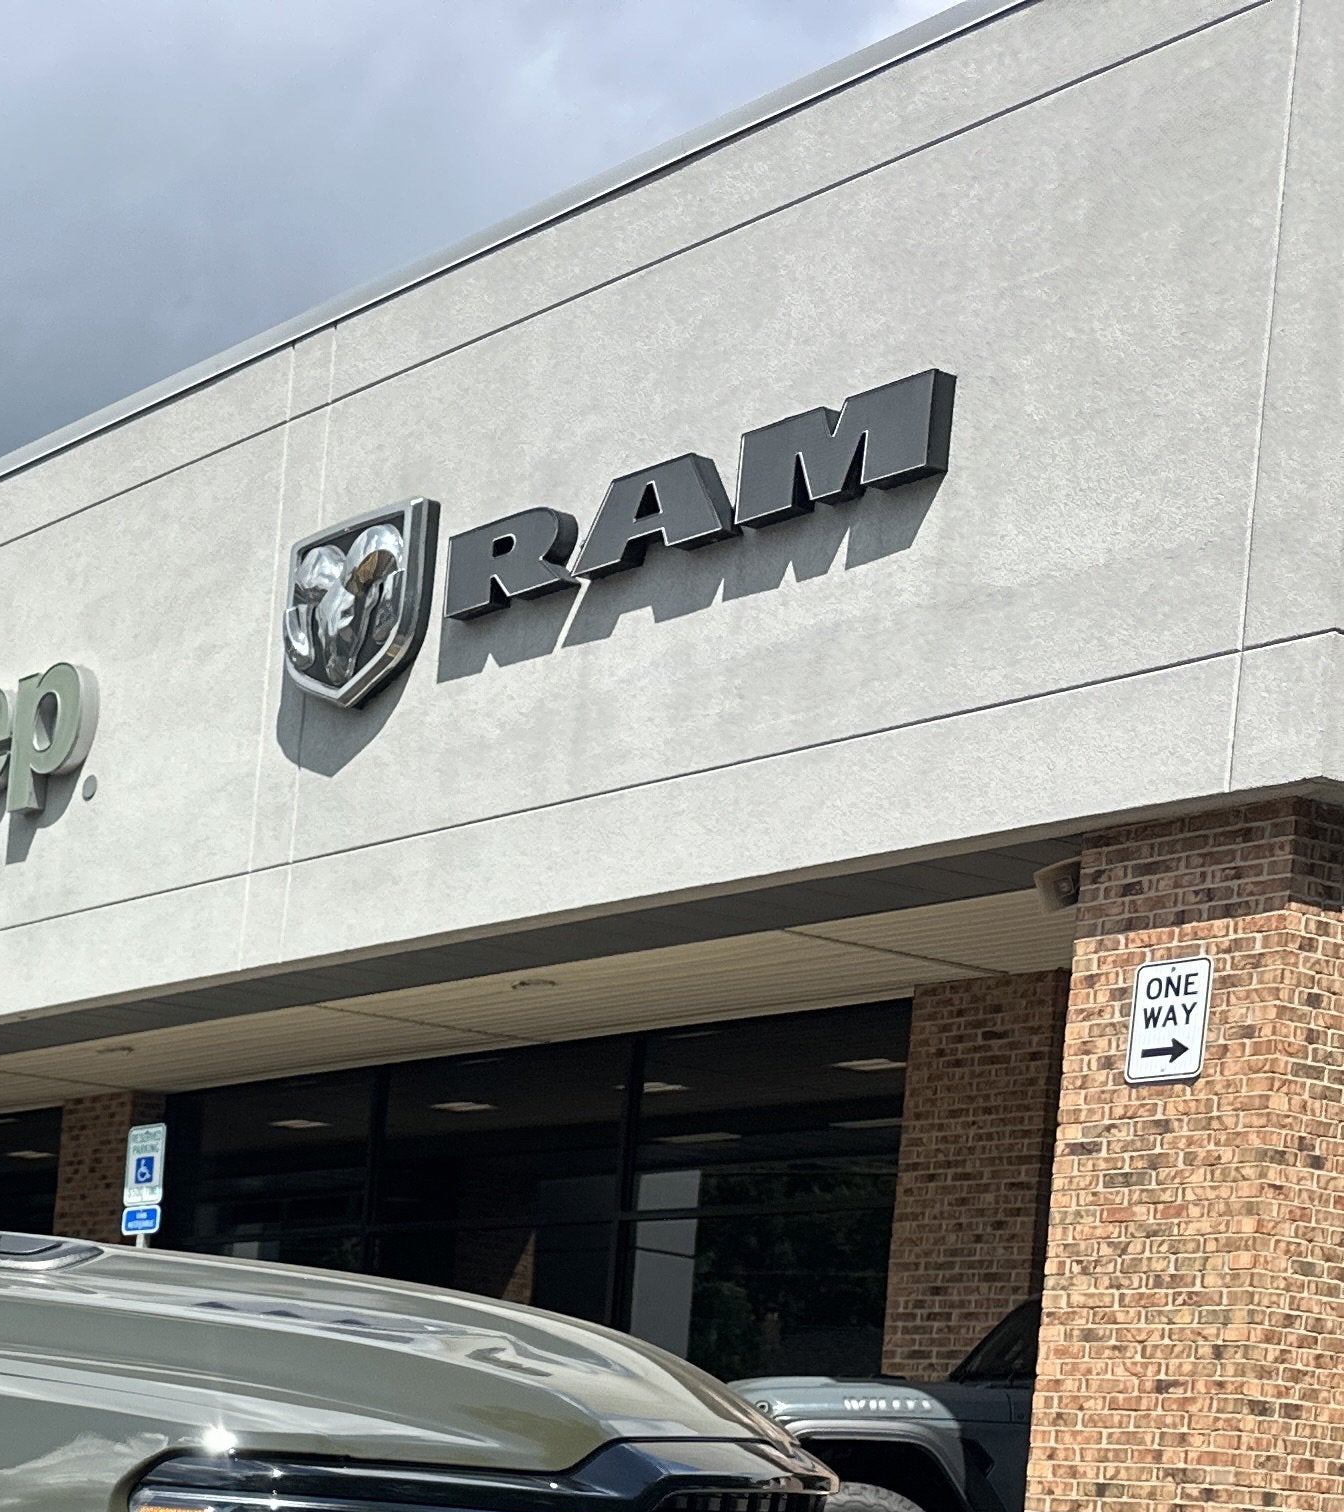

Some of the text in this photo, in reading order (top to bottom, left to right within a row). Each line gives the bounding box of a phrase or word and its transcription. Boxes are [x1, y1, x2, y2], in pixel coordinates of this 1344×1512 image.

[443, 368, 957, 620] RAM
[1146, 972, 1199, 1000] ONE
[1143, 1001, 1198, 1030] WAY
